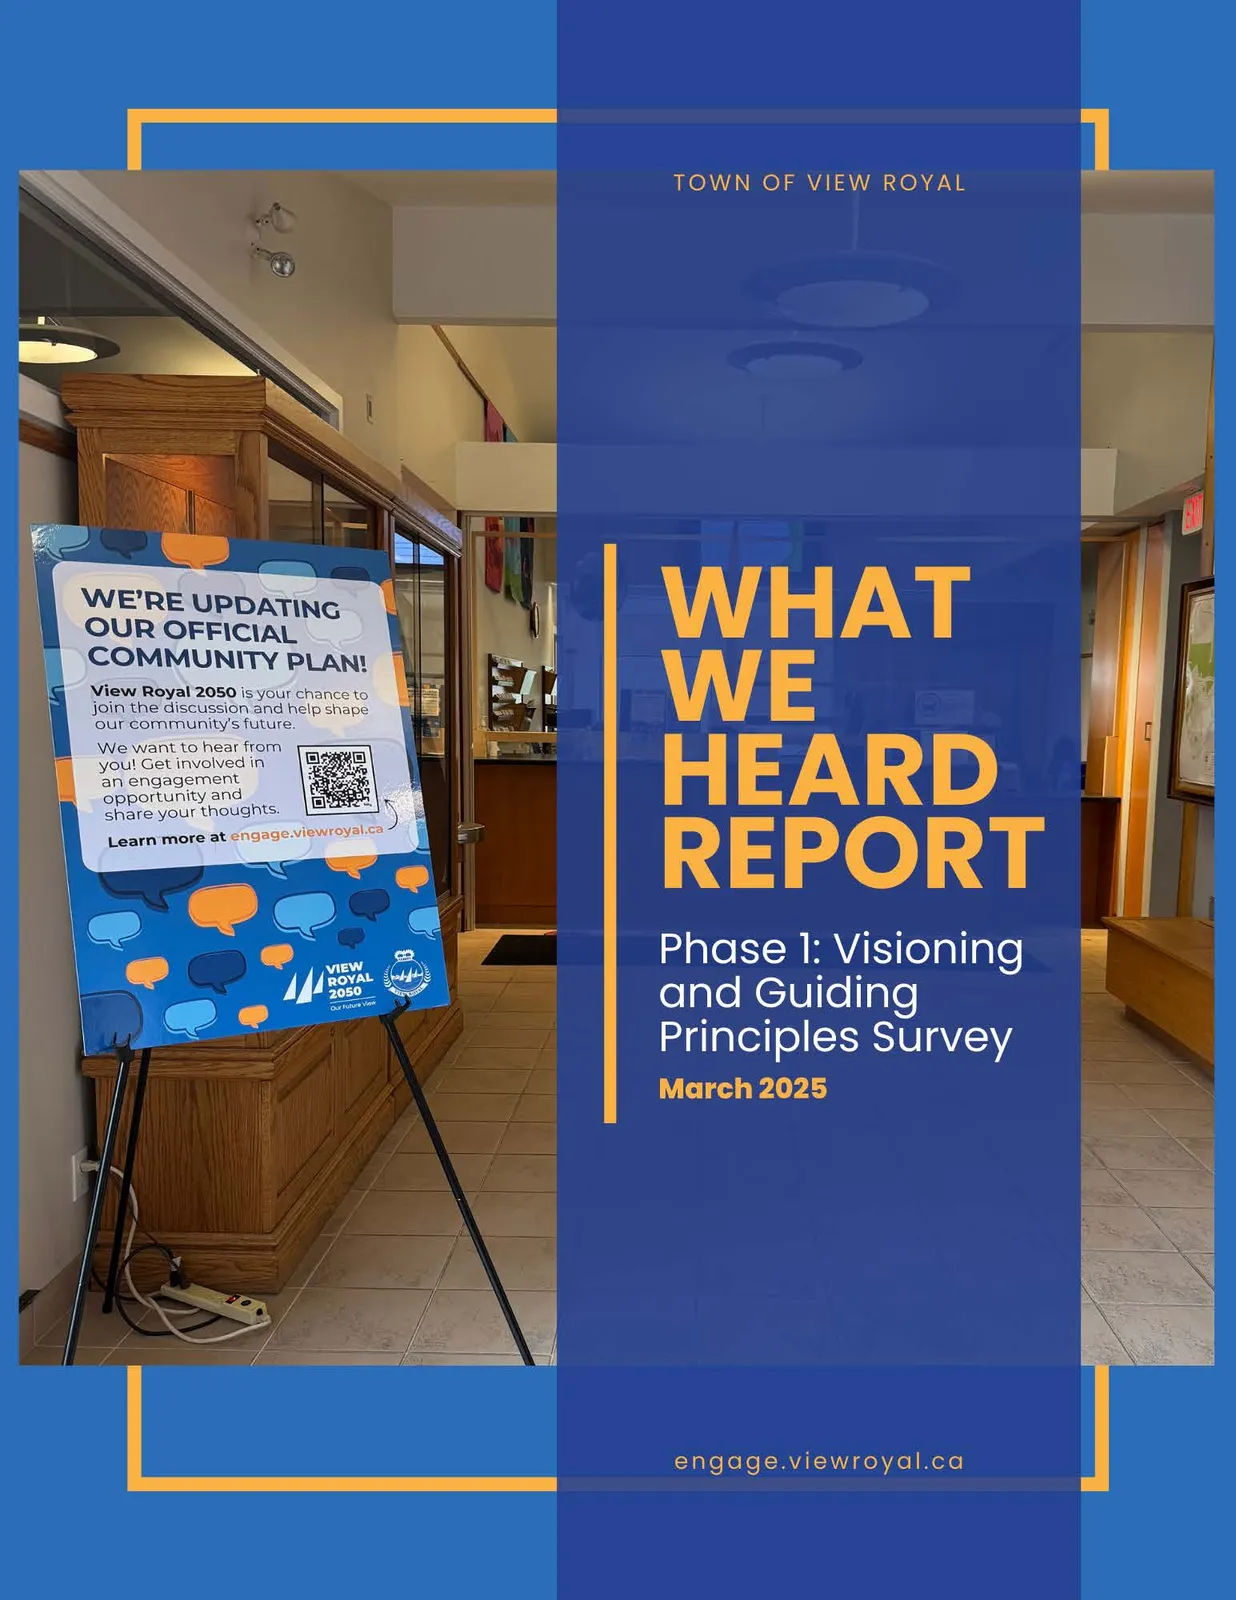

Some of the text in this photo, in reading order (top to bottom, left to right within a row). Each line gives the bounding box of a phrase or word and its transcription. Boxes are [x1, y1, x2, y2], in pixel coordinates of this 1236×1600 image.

[81, 587, 341, 620] WE’RE UPDATING
[84, 617, 298, 644] OUR OFFICIAL
[87, 646, 368, 673] COMMUNITY PLAN!
[90, 684, 369, 701] View Royal 2050 is your chance to
[92, 700, 369, 717] join the discussion and help shape
[95, 717, 296, 733] our community's future.
[97, 740, 282, 755] We want to hear from
[98, 756, 265, 774] you! Get involved in
[101, 773, 240, 791] an engagement
[102, 788, 242, 807] opportunity and
[104, 803, 280, 821] share your thoughts.
[108, 824, 384, 849] Learn more at engage.viewroyal.ca
[326, 961, 363, 974] VIEW
[328, 972, 374, 987] ROYAL
[329, 987, 362, 1000] 2050
[330, 1000, 377, 1012] Our Future View
